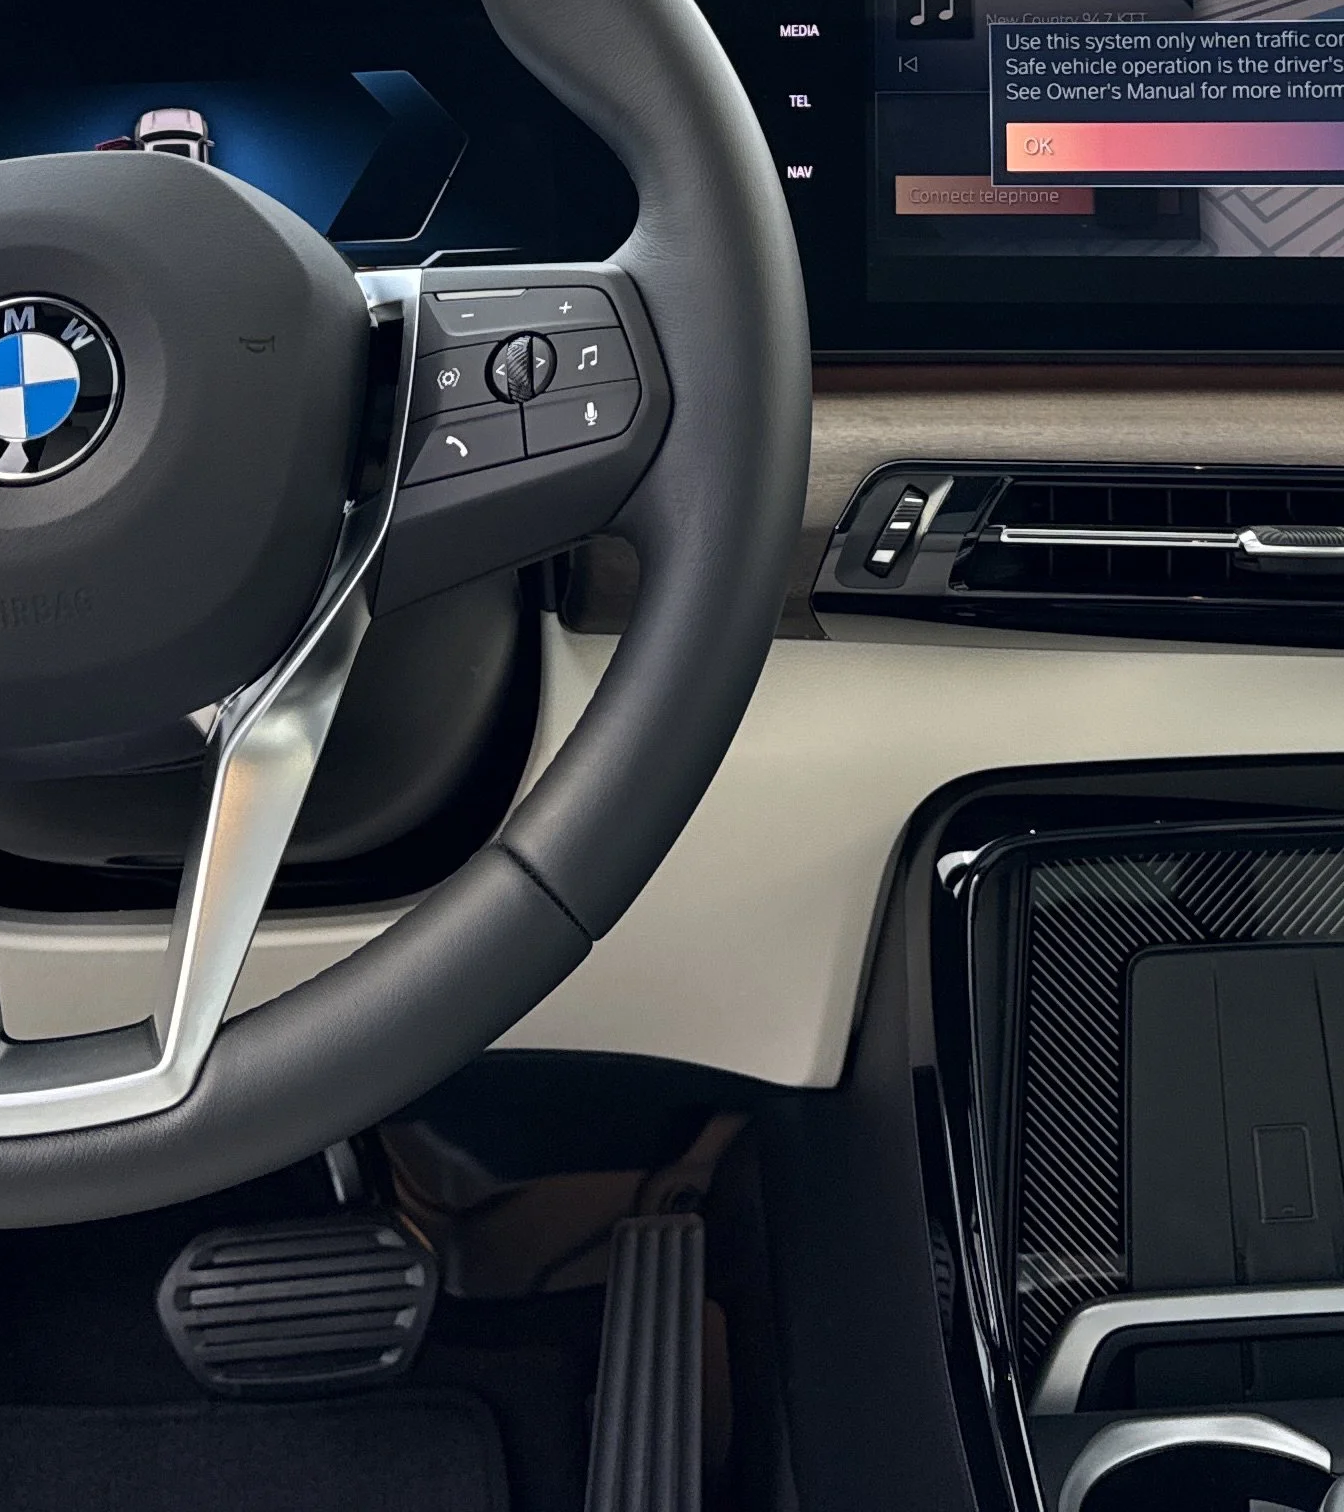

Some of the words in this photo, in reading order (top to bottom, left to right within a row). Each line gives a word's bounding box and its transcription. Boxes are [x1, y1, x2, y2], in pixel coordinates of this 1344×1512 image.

[779, 24, 820, 37] MEDIA
[1006, 33, 1041, 50] Use
[1046, 33, 1080, 50] this
[1085, 34, 1151, 54] system
[1156, 32, 1195, 52] only
[1200, 32, 1250, 49] when
[1256, 30, 1310, 48] traffic
[1006, 58, 1046, 75] Safe
[1051, 57, 1117, 74] vehicle
[1122, 57, 1212, 77] operation
[1217, 57, 1233, 73] is
[1238, 56, 1269, 73] the
[1274, 55, 1344, 73] driver's
[1006, 83, 1041, 100] See
[1046, 83, 1122, 100] Owner's
[1128, 82, 1195, 99] Manual
[1200, 81, 1227, 99] for
[1232, 85, 1281, 99] more
[789, 94, 811, 107] TEL
[1023, 137, 1054, 156] OK
[787, 165, 813, 178] NAV
[910, 188, 975, 204] Connect
[979, 189, 1060, 205] telephone
